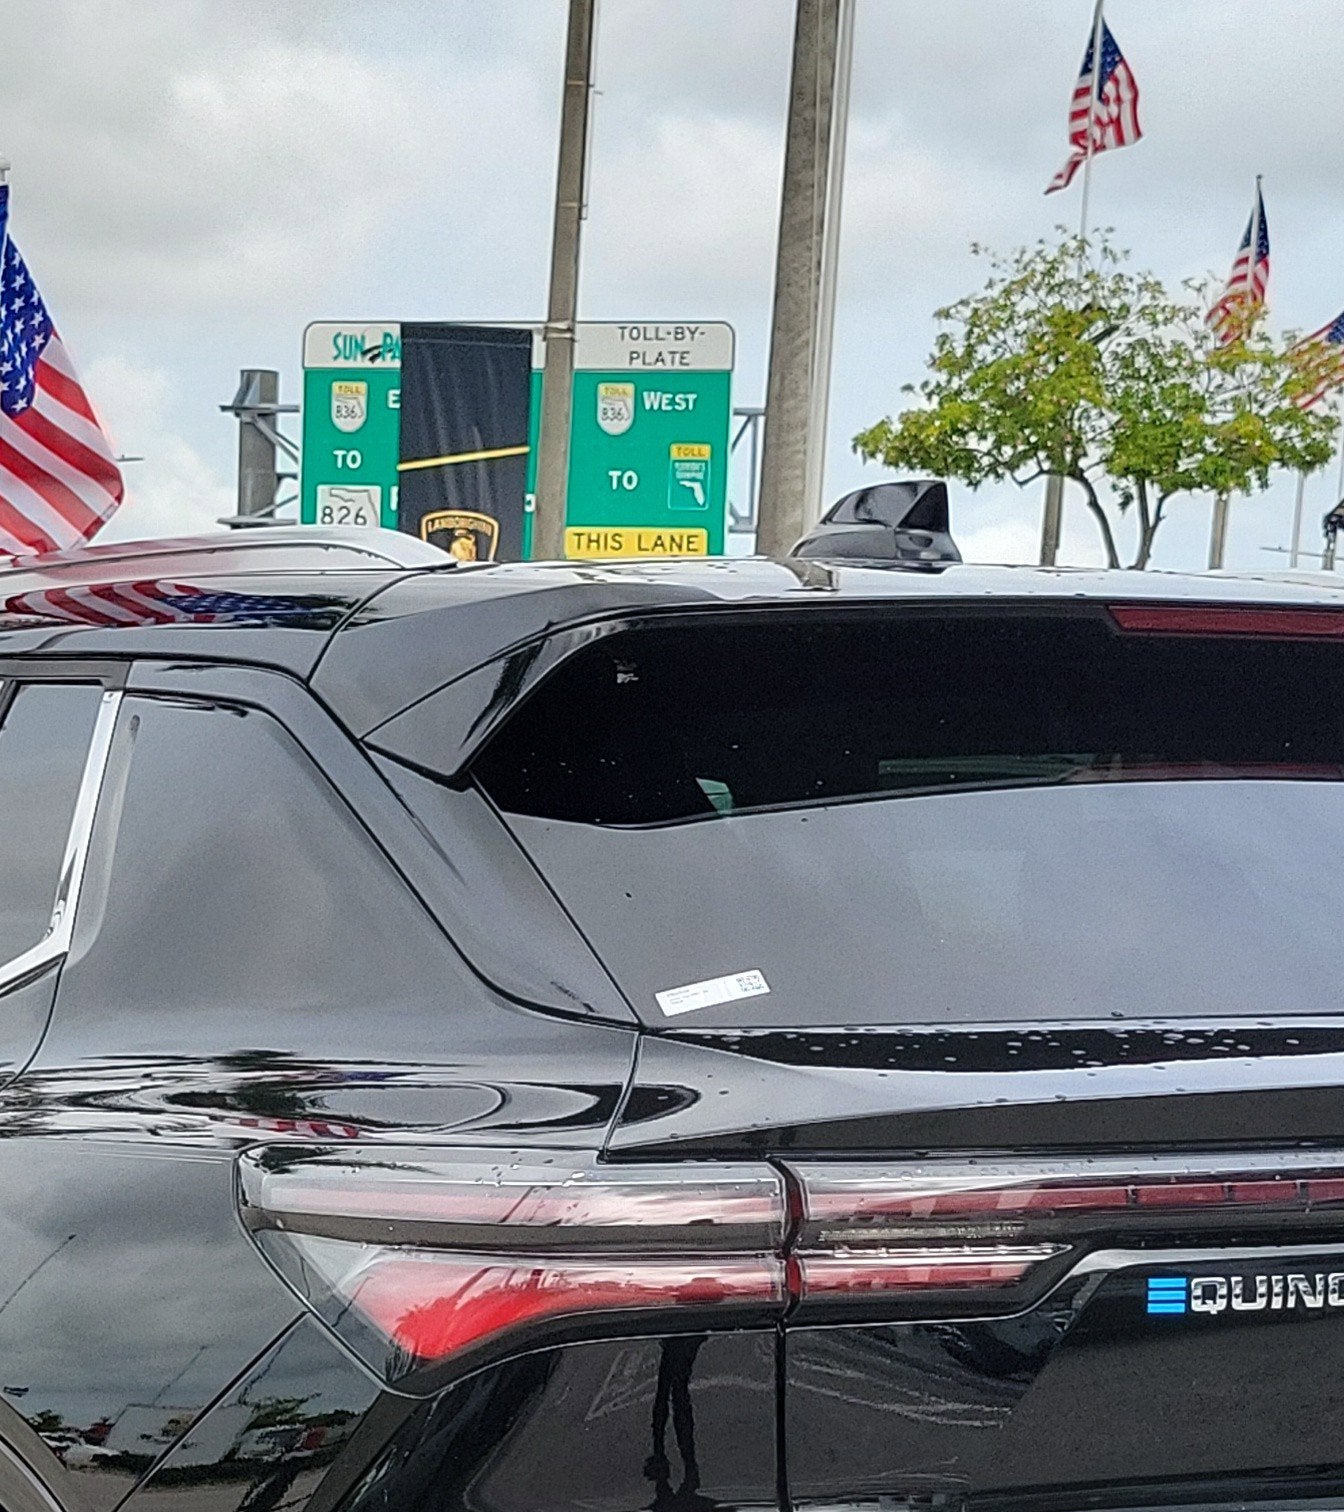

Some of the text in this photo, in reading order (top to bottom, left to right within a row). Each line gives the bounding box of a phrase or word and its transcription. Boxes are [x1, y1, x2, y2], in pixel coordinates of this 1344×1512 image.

[618, 326, 706, 341] TOLL-BY-
[629, 350, 691, 366] PLATE
[642, 391, 698, 411] WEST
[333, 449, 362, 469] TO
[675, 446, 706, 457] TOLL
[608, 470, 639, 491] TO
[320, 505, 367, 526] 826
[573, 532, 700, 553] THIS LANE
